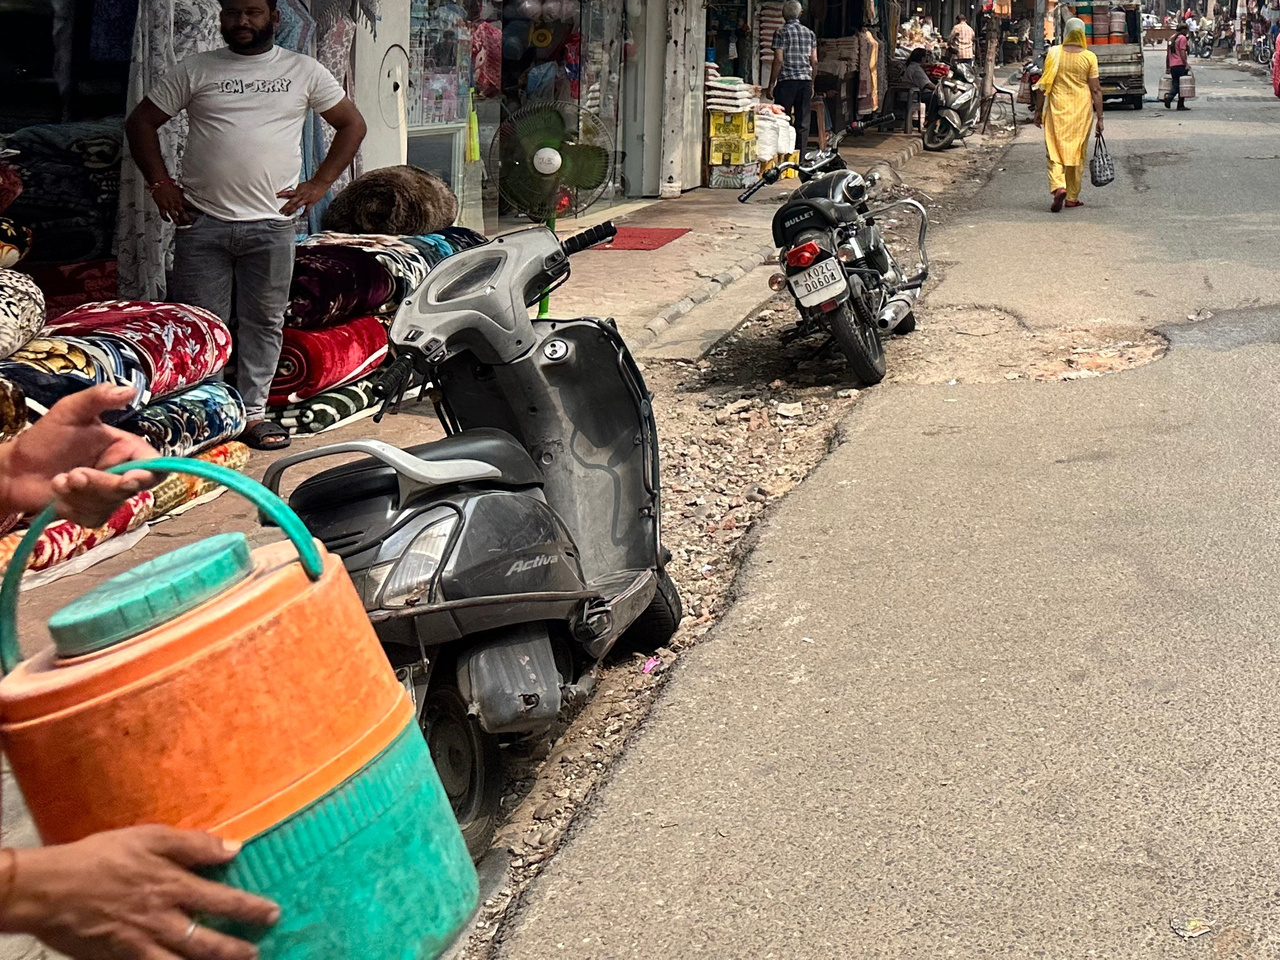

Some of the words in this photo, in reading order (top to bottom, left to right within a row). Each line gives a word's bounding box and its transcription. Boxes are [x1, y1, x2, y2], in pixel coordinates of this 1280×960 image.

[216, 79, 243, 94] TOM
[251, 78, 291, 93] JERRY
[784, 210, 815, 228] BULLET
[803, 262, 833, 283] JK02C
[505, 553, 559, 577] Activa
